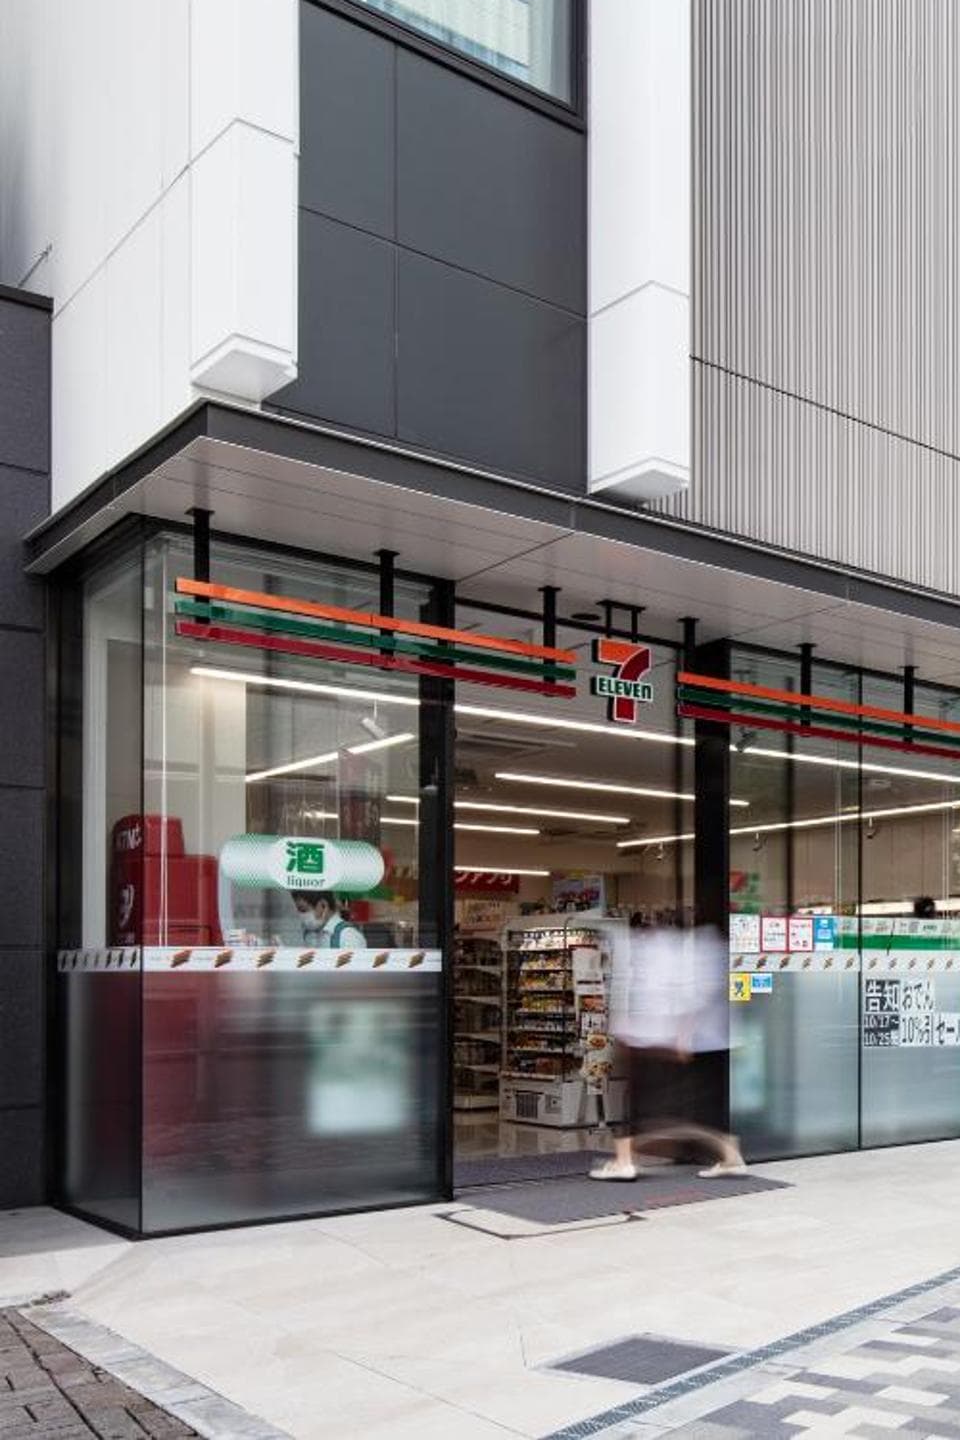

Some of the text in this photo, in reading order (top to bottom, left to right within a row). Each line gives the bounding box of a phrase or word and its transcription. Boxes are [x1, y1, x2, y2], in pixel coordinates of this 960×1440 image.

[286, 841, 325, 874] 酒
[287, 875, 326, 888] liquor
[867, 981, 933, 1011] 告知 おでん
